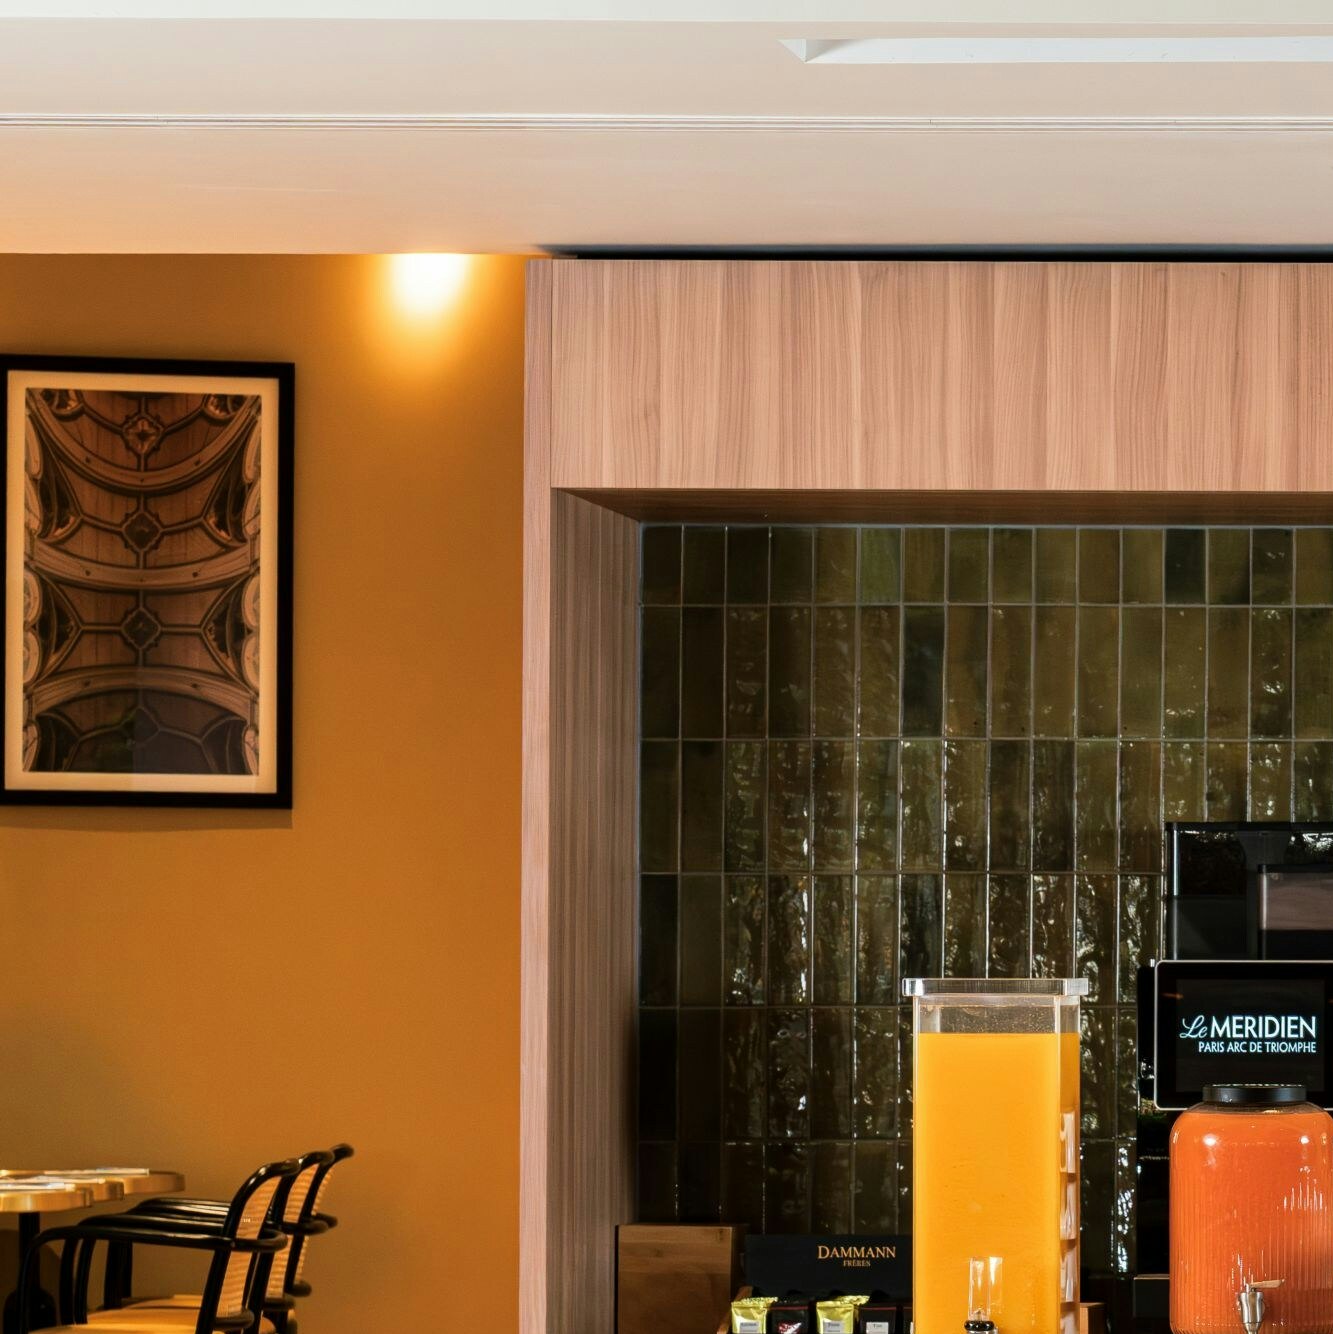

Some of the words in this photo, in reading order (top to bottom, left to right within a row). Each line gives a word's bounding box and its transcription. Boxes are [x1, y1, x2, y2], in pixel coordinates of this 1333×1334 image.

[1180, 1015, 1207, 1038] Le
[1211, 1016, 1316, 1037] MERIDIEN
[1199, 1042, 1224, 1053] PARIS
[1227, 1042, 1247, 1053] ARC
[1250, 1042, 1262, 1053] DE
[1266, 1042, 1316, 1053] TRIOMPHE
[817, 1245, 896, 1259] DAMMANN
